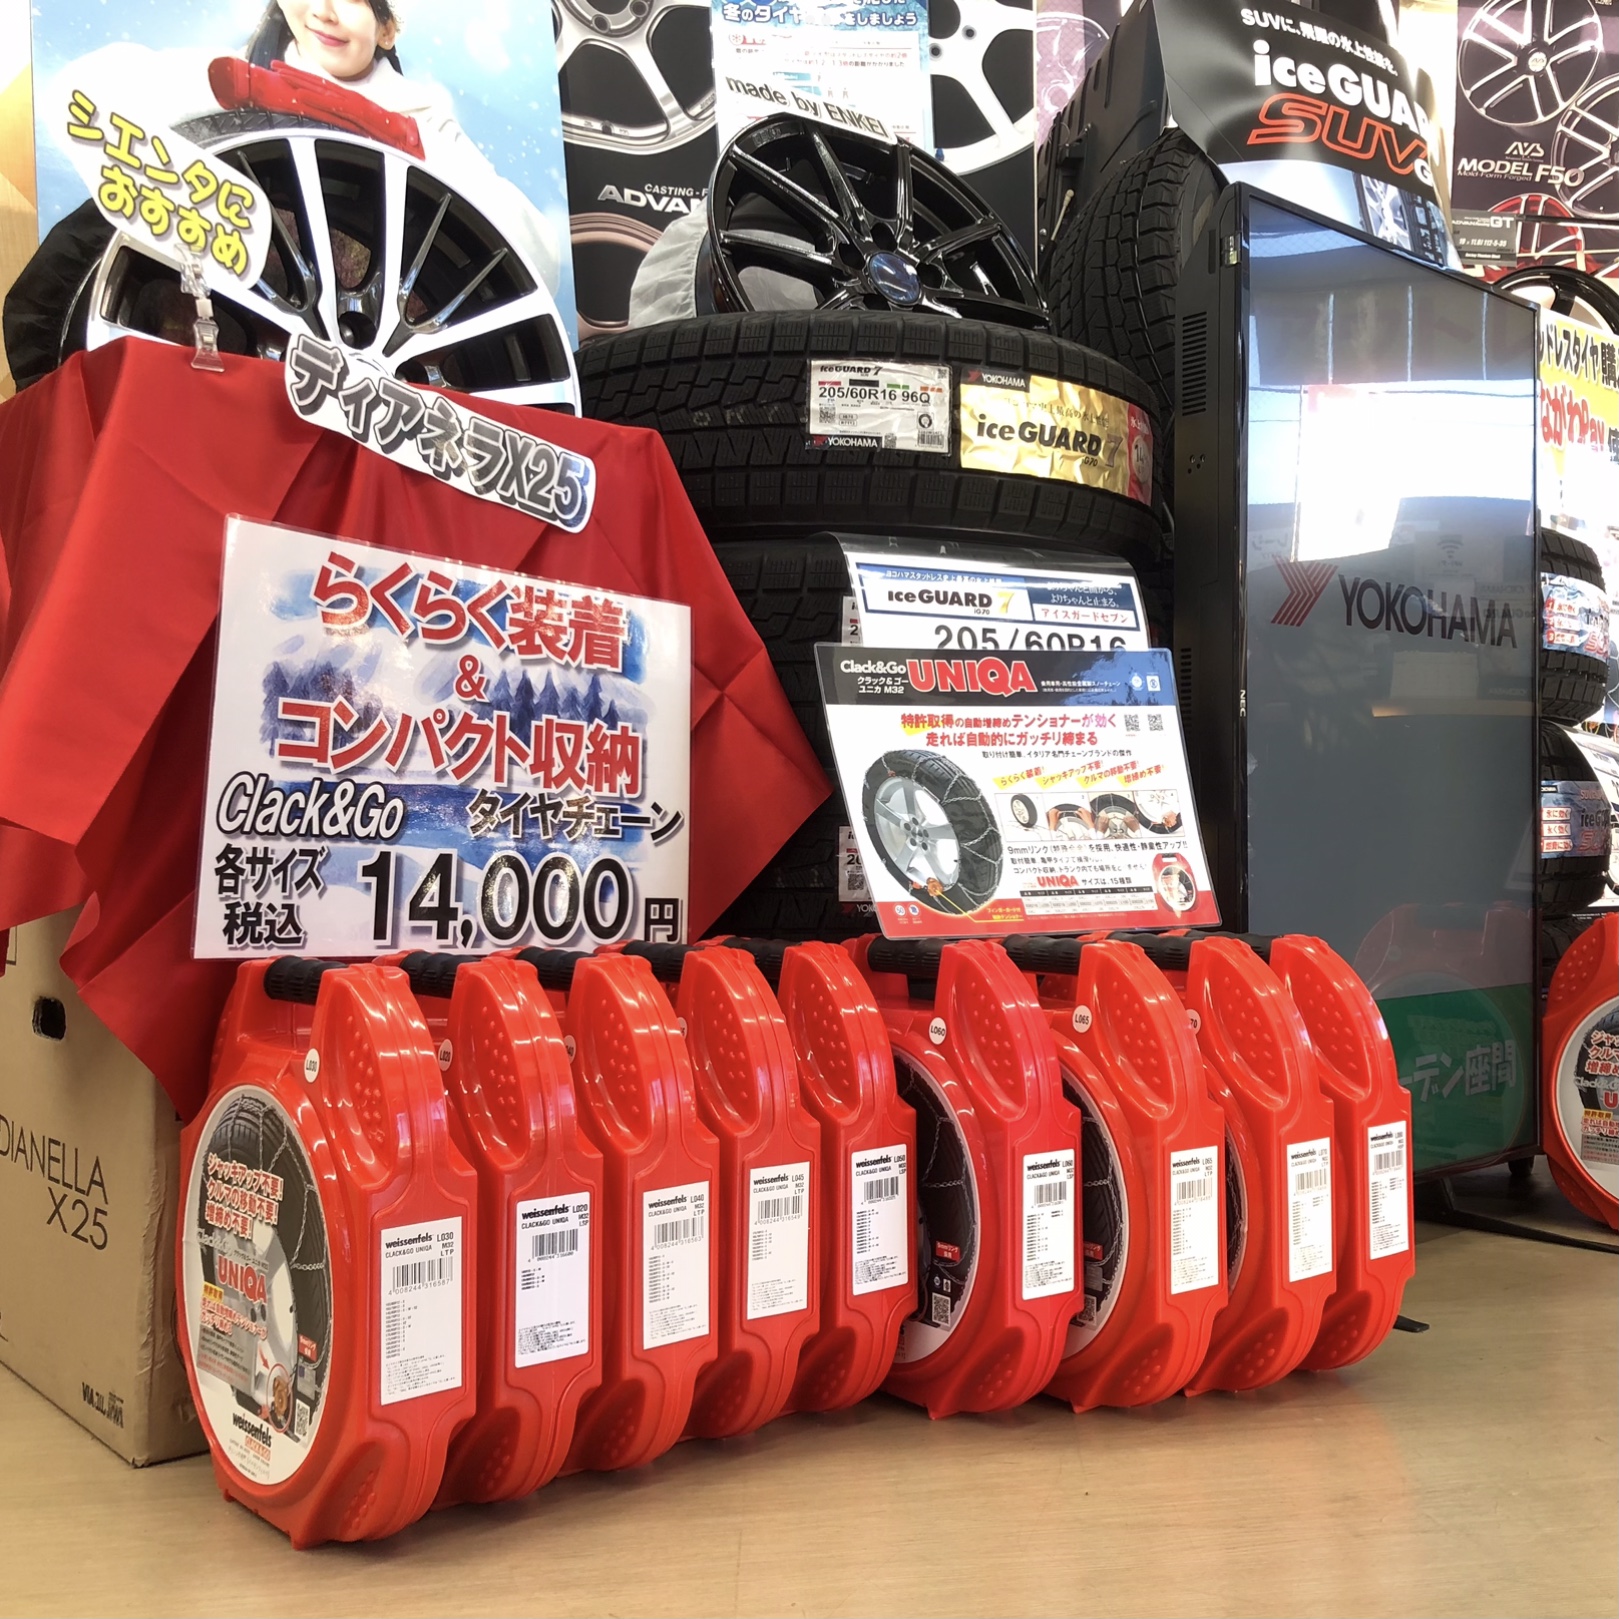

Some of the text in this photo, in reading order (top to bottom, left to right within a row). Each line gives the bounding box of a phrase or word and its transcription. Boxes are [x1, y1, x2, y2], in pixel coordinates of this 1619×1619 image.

[725, 77, 889, 138] made by ENKEI
[67, 89, 255, 228] シエンタに
[1457, 158, 1585, 188] MODEL F50
[98, 165, 249, 275] おすすめ
[819, 386, 931, 403] 205/60R16 96Q
[982, 374, 1027, 388] YOKOHAMA
[287, 334, 592, 528] ディアネラX25
[828, 437, 878, 448] YOKOHAMA
[1105, 433, 1124, 469] 7
[311, 550, 626, 674] らくらく装着
[996, 591, 1015, 613] 7
[1040, 608, 1129, 624] アイスガードセブン
[1338, 573, 1518, 649] YOKOHAMA
[453, 653, 488, 703] &
[841, 656, 1038, 698] Clack&Go UNIQA
[858, 686, 905, 695] ユニカ M32
[276, 696, 641, 798] コンパクト収納
[214, 770, 405, 841] Clack&Go
[467, 786, 685, 846] タイヤチェーン
[214, 842, 329, 898] 各サイズ
[1036, 874, 1080, 889] UNIQA
[360, 847, 630, 949] 14,000
[222, 900, 303, 947] 税込
[644, 896, 682, 943] 円
[930, 1025, 946, 1037] L060
[1074, 1014, 1090, 1026] L065
[0, 1114, 109, 1206] DIANELLA
[208, 1151, 284, 1202] ジャッキアップ不要!
[753, 1173, 805, 1186] weissenfels L045
[856, 1154, 892, 1169] weissenfels
[1172, 1157, 1201, 1168] weissenfels
[46, 1186, 109, 1251] X25
[204, 1199, 254, 1241] 増締め不要!
[206, 1176, 280, 1226] クルマの移動不要!
[522, 1203, 589, 1221] weissenfels L020
[648, 1194, 705, 1209] weissenfels L040
[385, 1231, 454, 1249] weissenfels L030
[521, 1219, 551, 1230] CLACK&GO
[385, 1241, 454, 1259] CLACK&GO UNIQA M32
[217, 1254, 268, 1305] UNIQA
[233, 1413, 272, 1448] weissenfels
